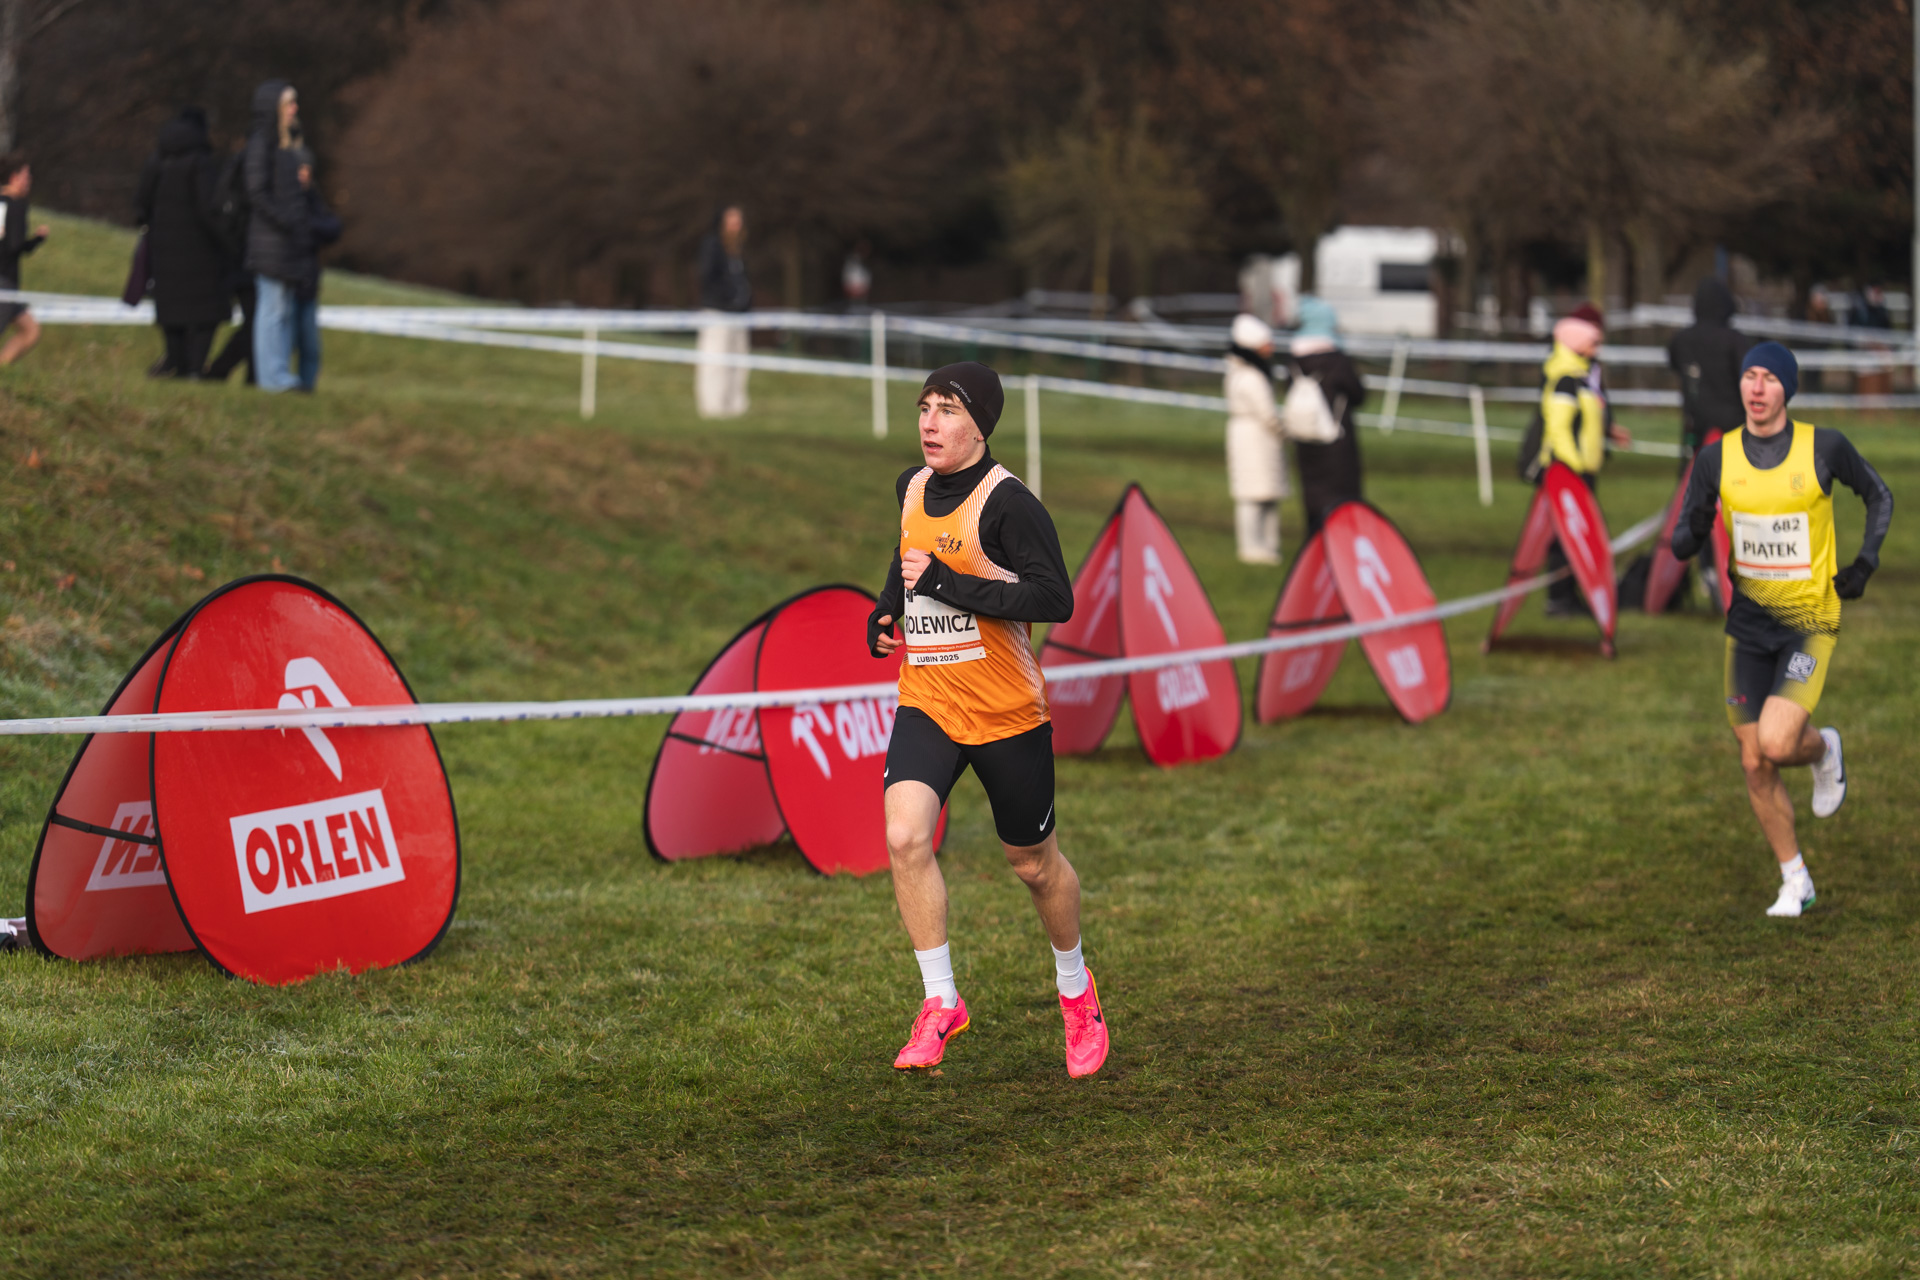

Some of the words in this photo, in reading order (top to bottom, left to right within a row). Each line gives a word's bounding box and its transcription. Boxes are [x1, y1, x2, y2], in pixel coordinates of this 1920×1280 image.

[1773, 518, 1800, 533] 682
[1743, 541, 1797, 559] PIĄTEK
[917, 655, 938, 663] LUBIN
[940, 654, 959, 662] 2025
[246, 806, 390, 895] ORLEN
